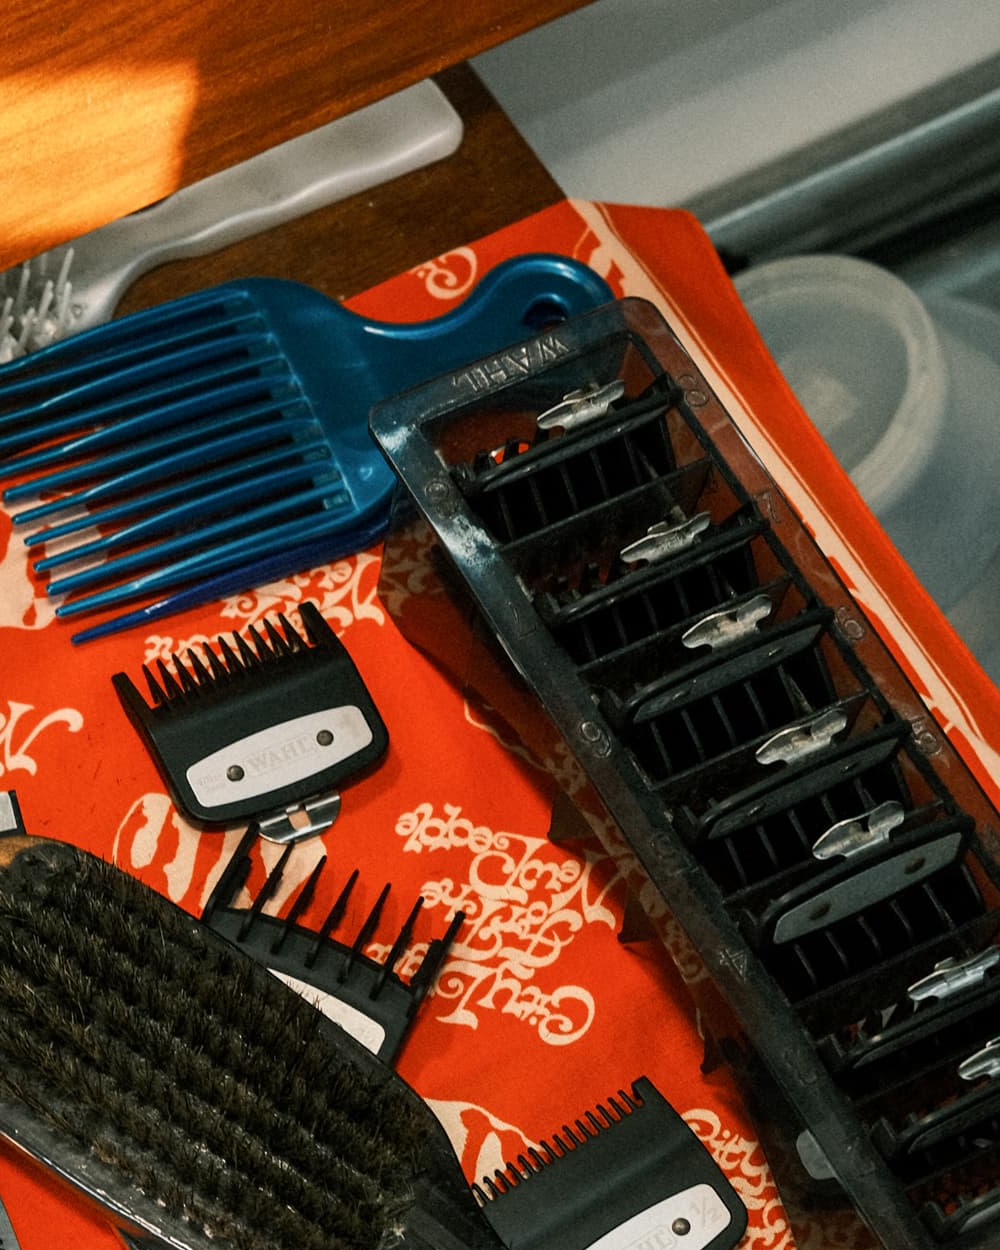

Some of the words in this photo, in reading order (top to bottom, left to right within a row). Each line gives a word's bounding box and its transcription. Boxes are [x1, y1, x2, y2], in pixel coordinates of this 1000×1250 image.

[452, 334, 571, 394] WAHL
[246, 733, 315, 774] WAHL
[395, 803, 547, 905] People
[477, 959, 596, 1046] City
